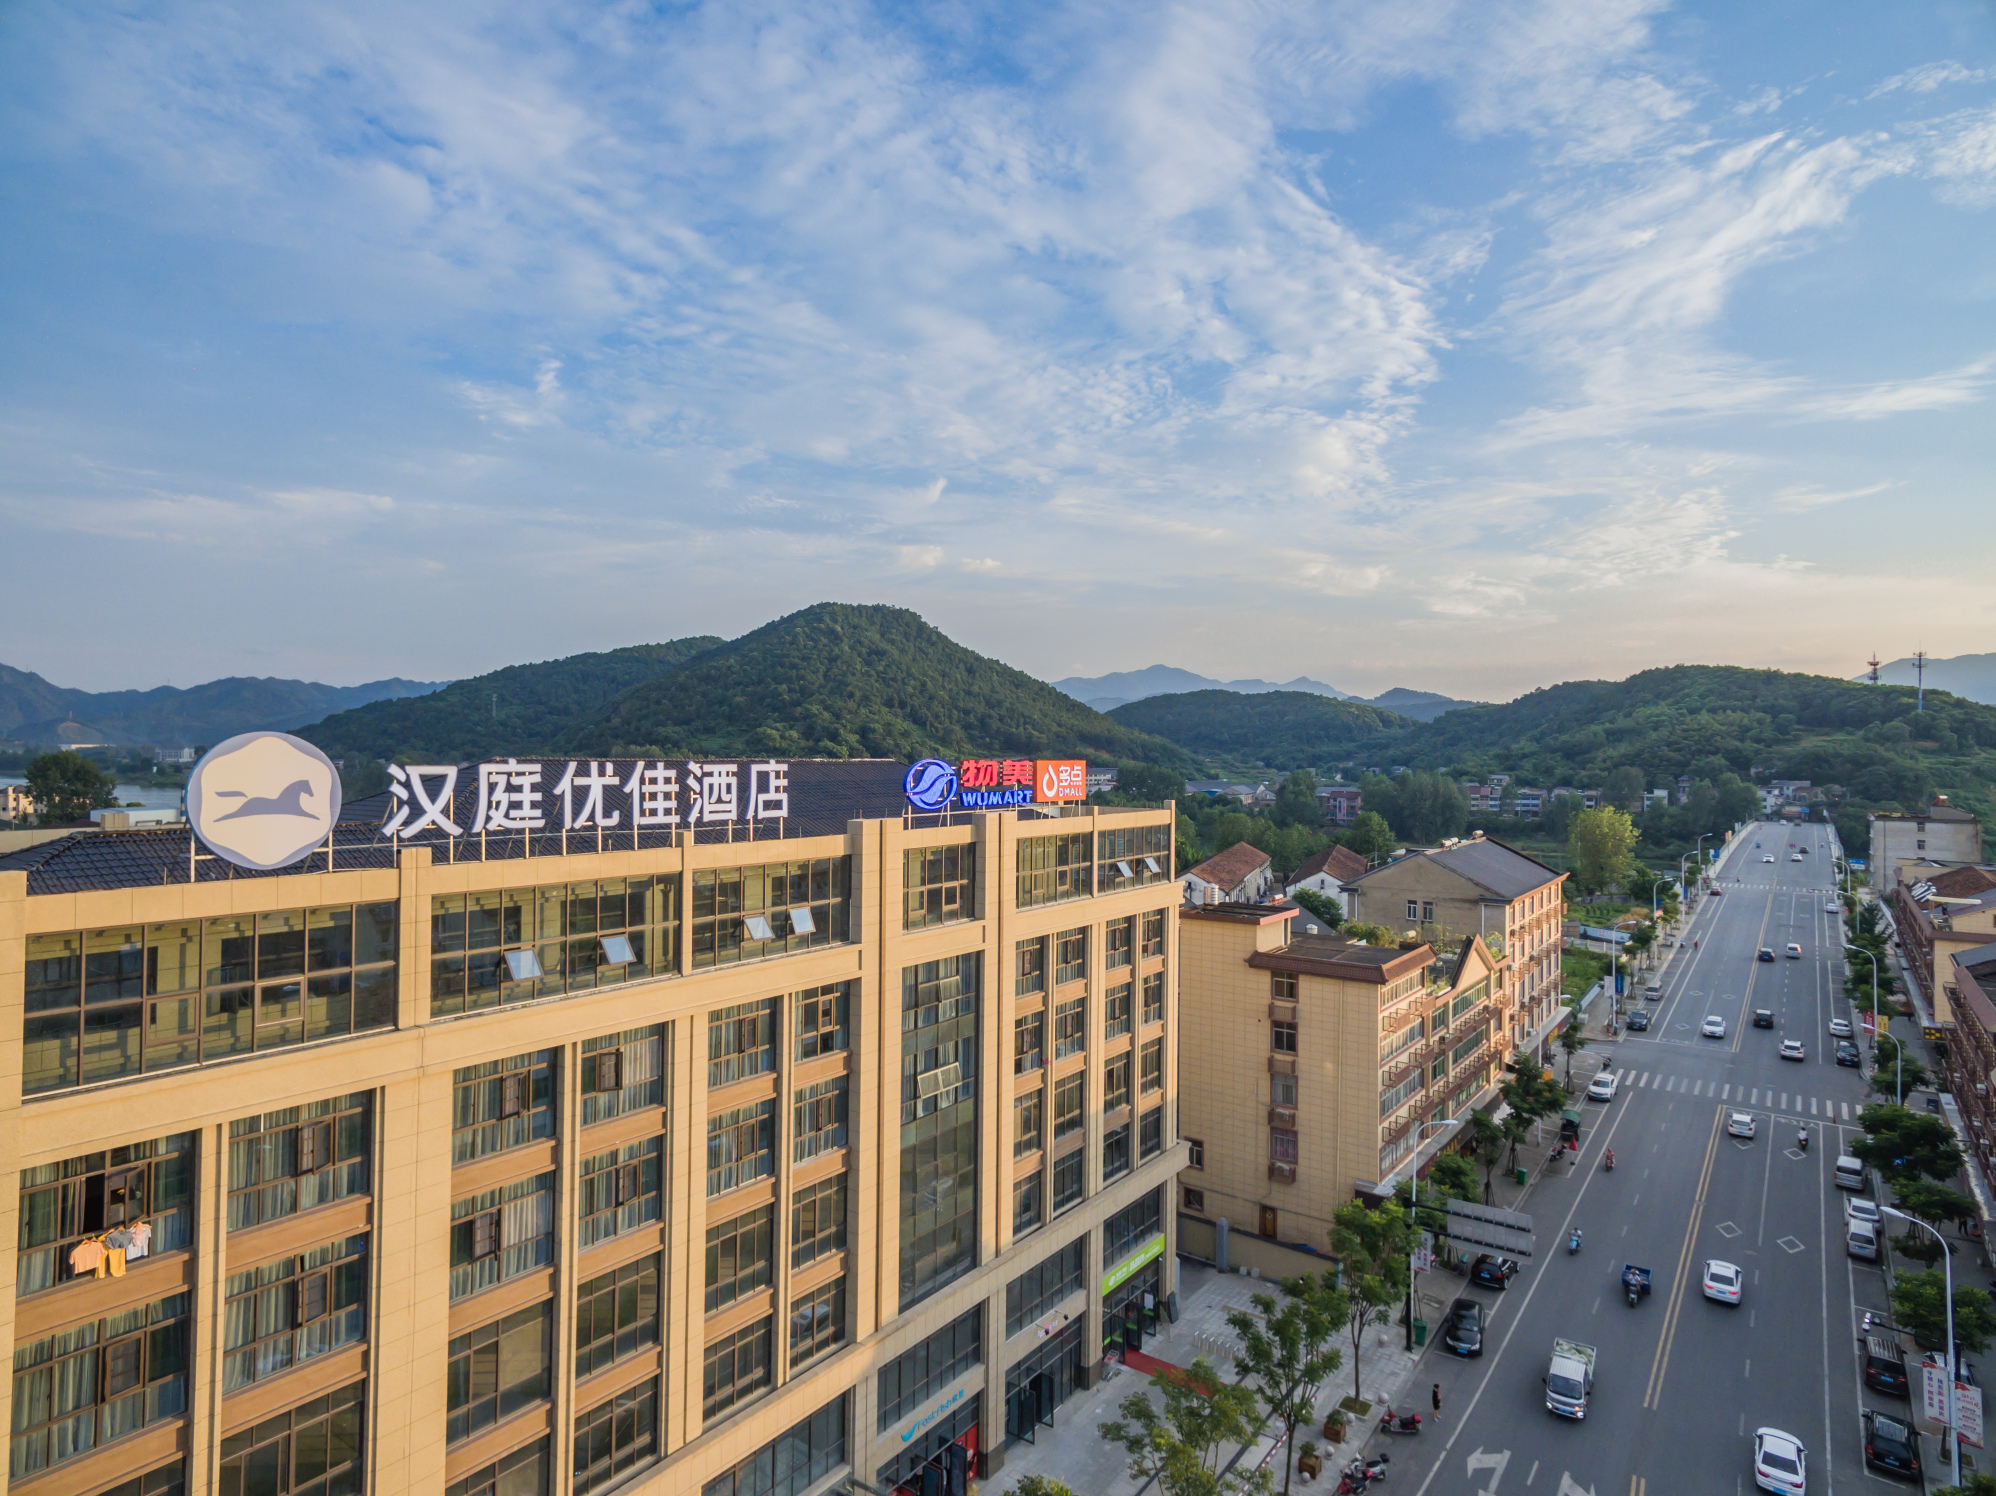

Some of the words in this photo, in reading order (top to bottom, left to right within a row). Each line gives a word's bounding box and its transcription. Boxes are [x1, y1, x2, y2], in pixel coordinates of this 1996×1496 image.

[960, 760, 1034, 787] 物美
[1058, 765, 1082, 787] 多点
[382, 758, 788, 839] 汉庭优佳酒店
[960, 789, 1034, 807] WUMART
[1058, 787, 1082, 797] DMALL
